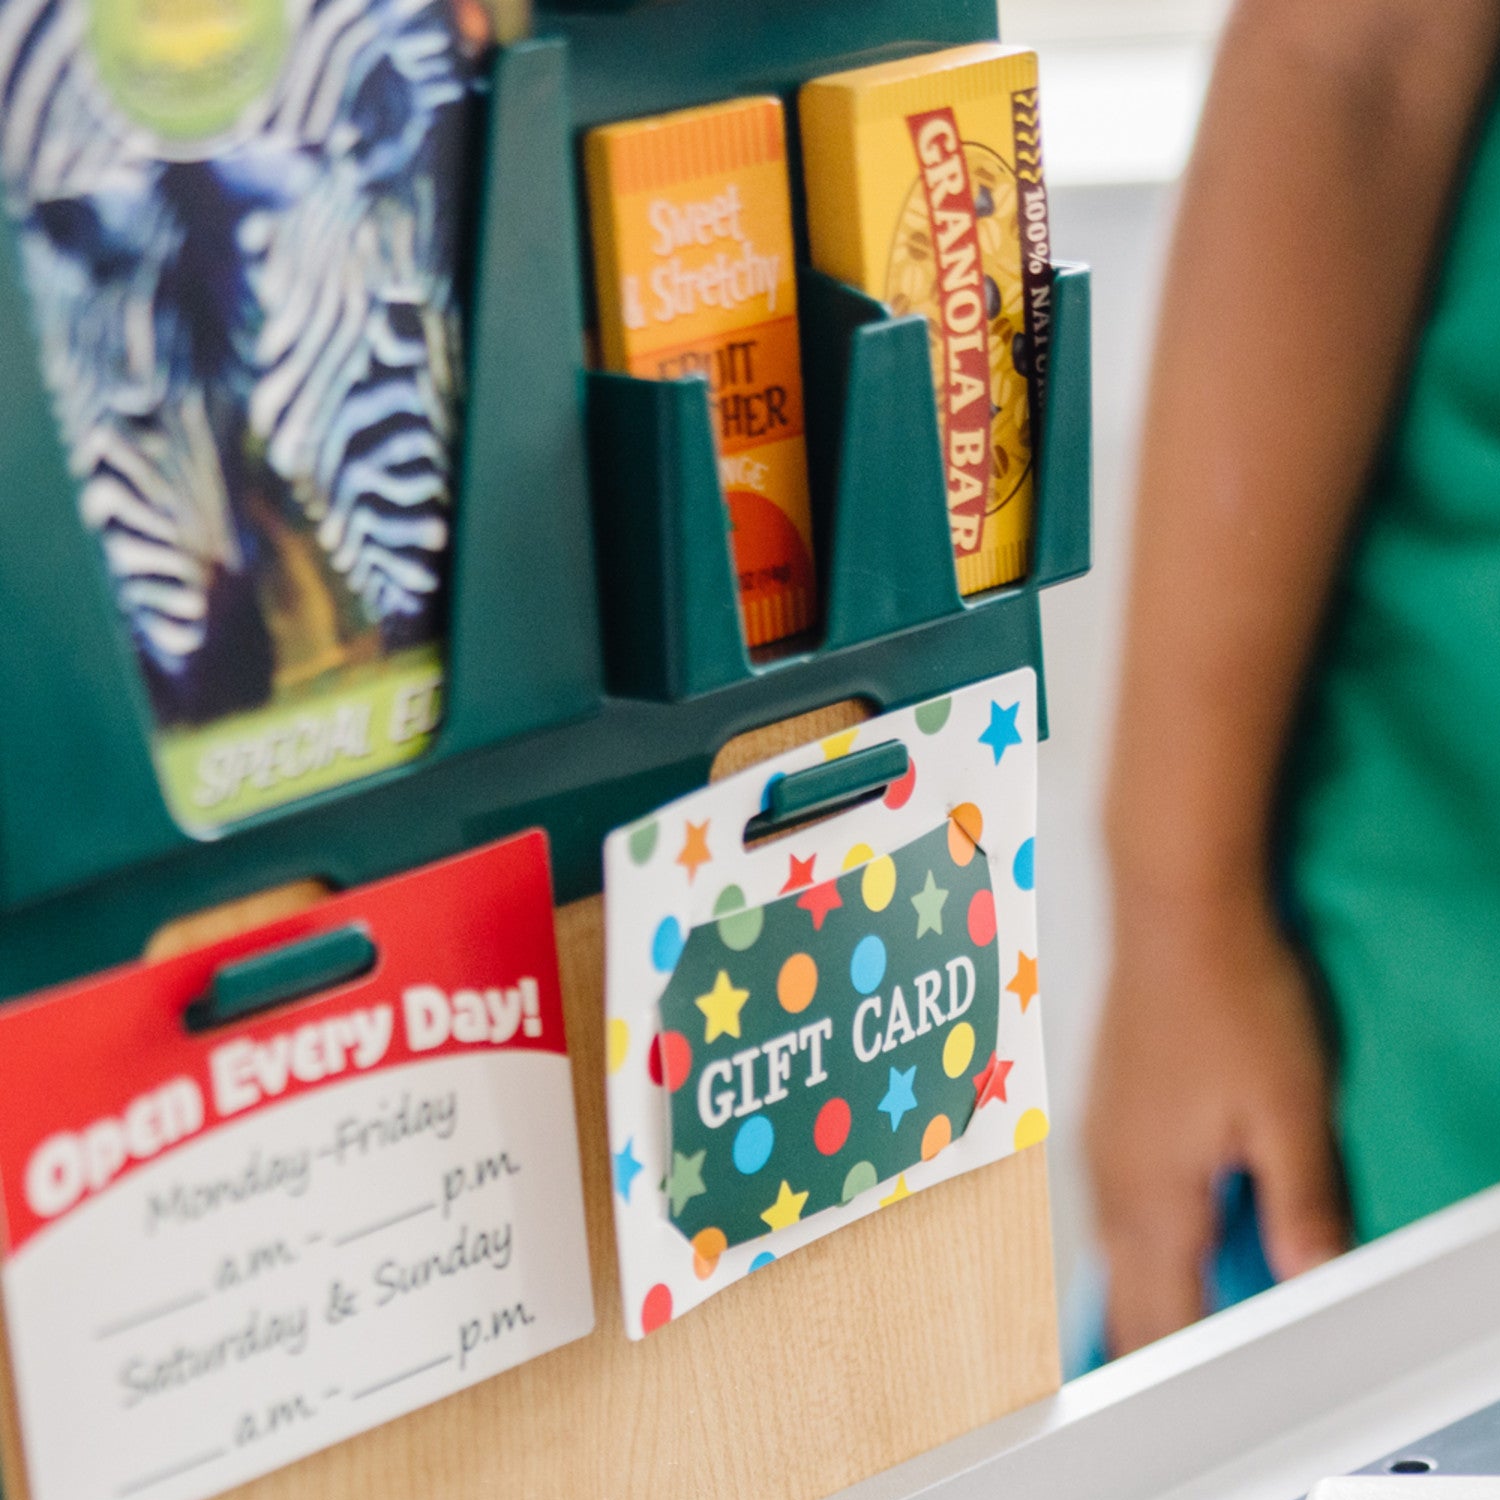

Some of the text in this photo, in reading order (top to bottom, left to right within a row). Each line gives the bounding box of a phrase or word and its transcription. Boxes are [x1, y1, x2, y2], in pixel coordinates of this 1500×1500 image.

[648, 183, 744, 257] Sweet
[651, 241, 780, 322] Stretchy
[1023, 185, 1049, 275] 100%
[917, 118, 986, 551] GRANOLA BAR
[191, 702, 371, 807] SPECIAL
[24, 977, 544, 1218] Open Every Day!
[697, 955, 976, 1129] GIFT CARD
[119, 1222, 513, 1411] Saturday & Sunday
